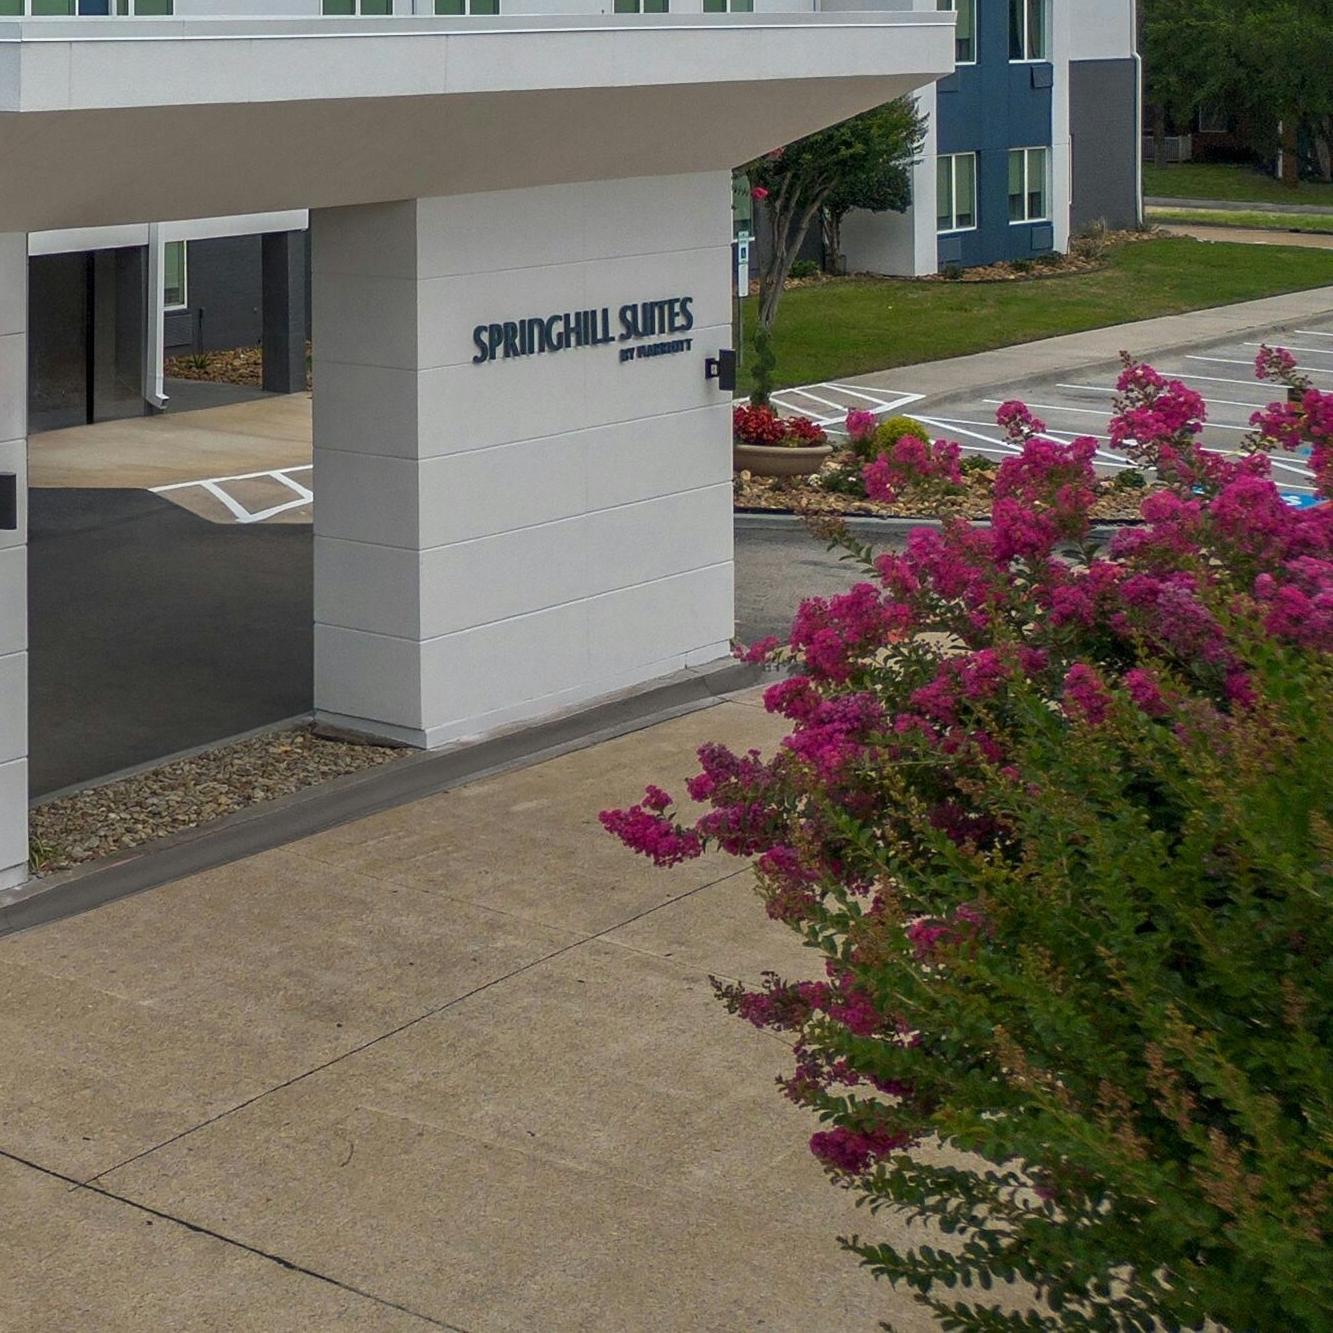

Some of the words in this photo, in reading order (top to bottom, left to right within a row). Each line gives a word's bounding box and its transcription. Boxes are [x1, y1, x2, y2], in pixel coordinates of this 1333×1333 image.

[472, 308, 615, 363] SPRINGHILL
[618, 297, 694, 340] SUITES
[619, 347, 635, 362] BY
